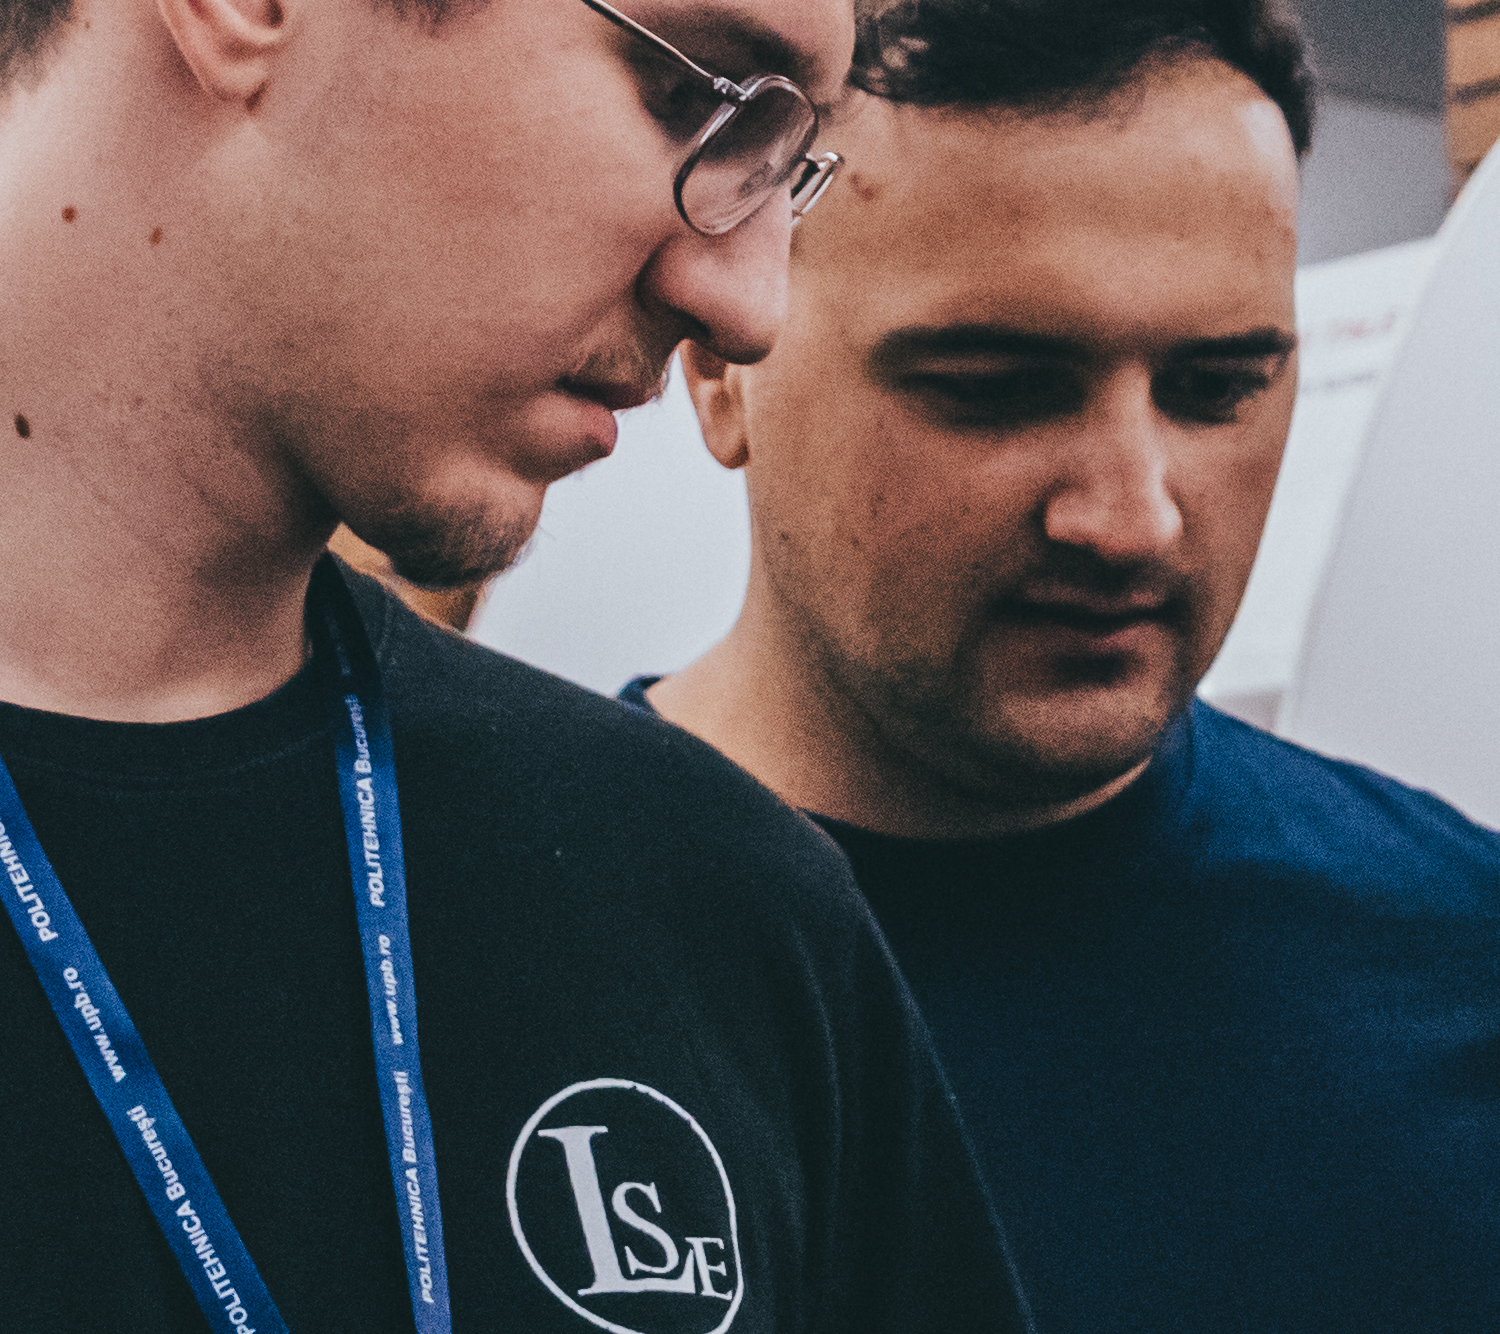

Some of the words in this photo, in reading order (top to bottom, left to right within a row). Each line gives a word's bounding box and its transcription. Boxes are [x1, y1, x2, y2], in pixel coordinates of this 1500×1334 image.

[354, 776, 386, 909] POLITEHNICA
[63, 966, 127, 1083] www.upb.ro
[378, 933, 404, 1046] www.upb.ro
[403, 1167, 436, 1305] POLITEHNICA
[537, 1124, 734, 1301] LSE
